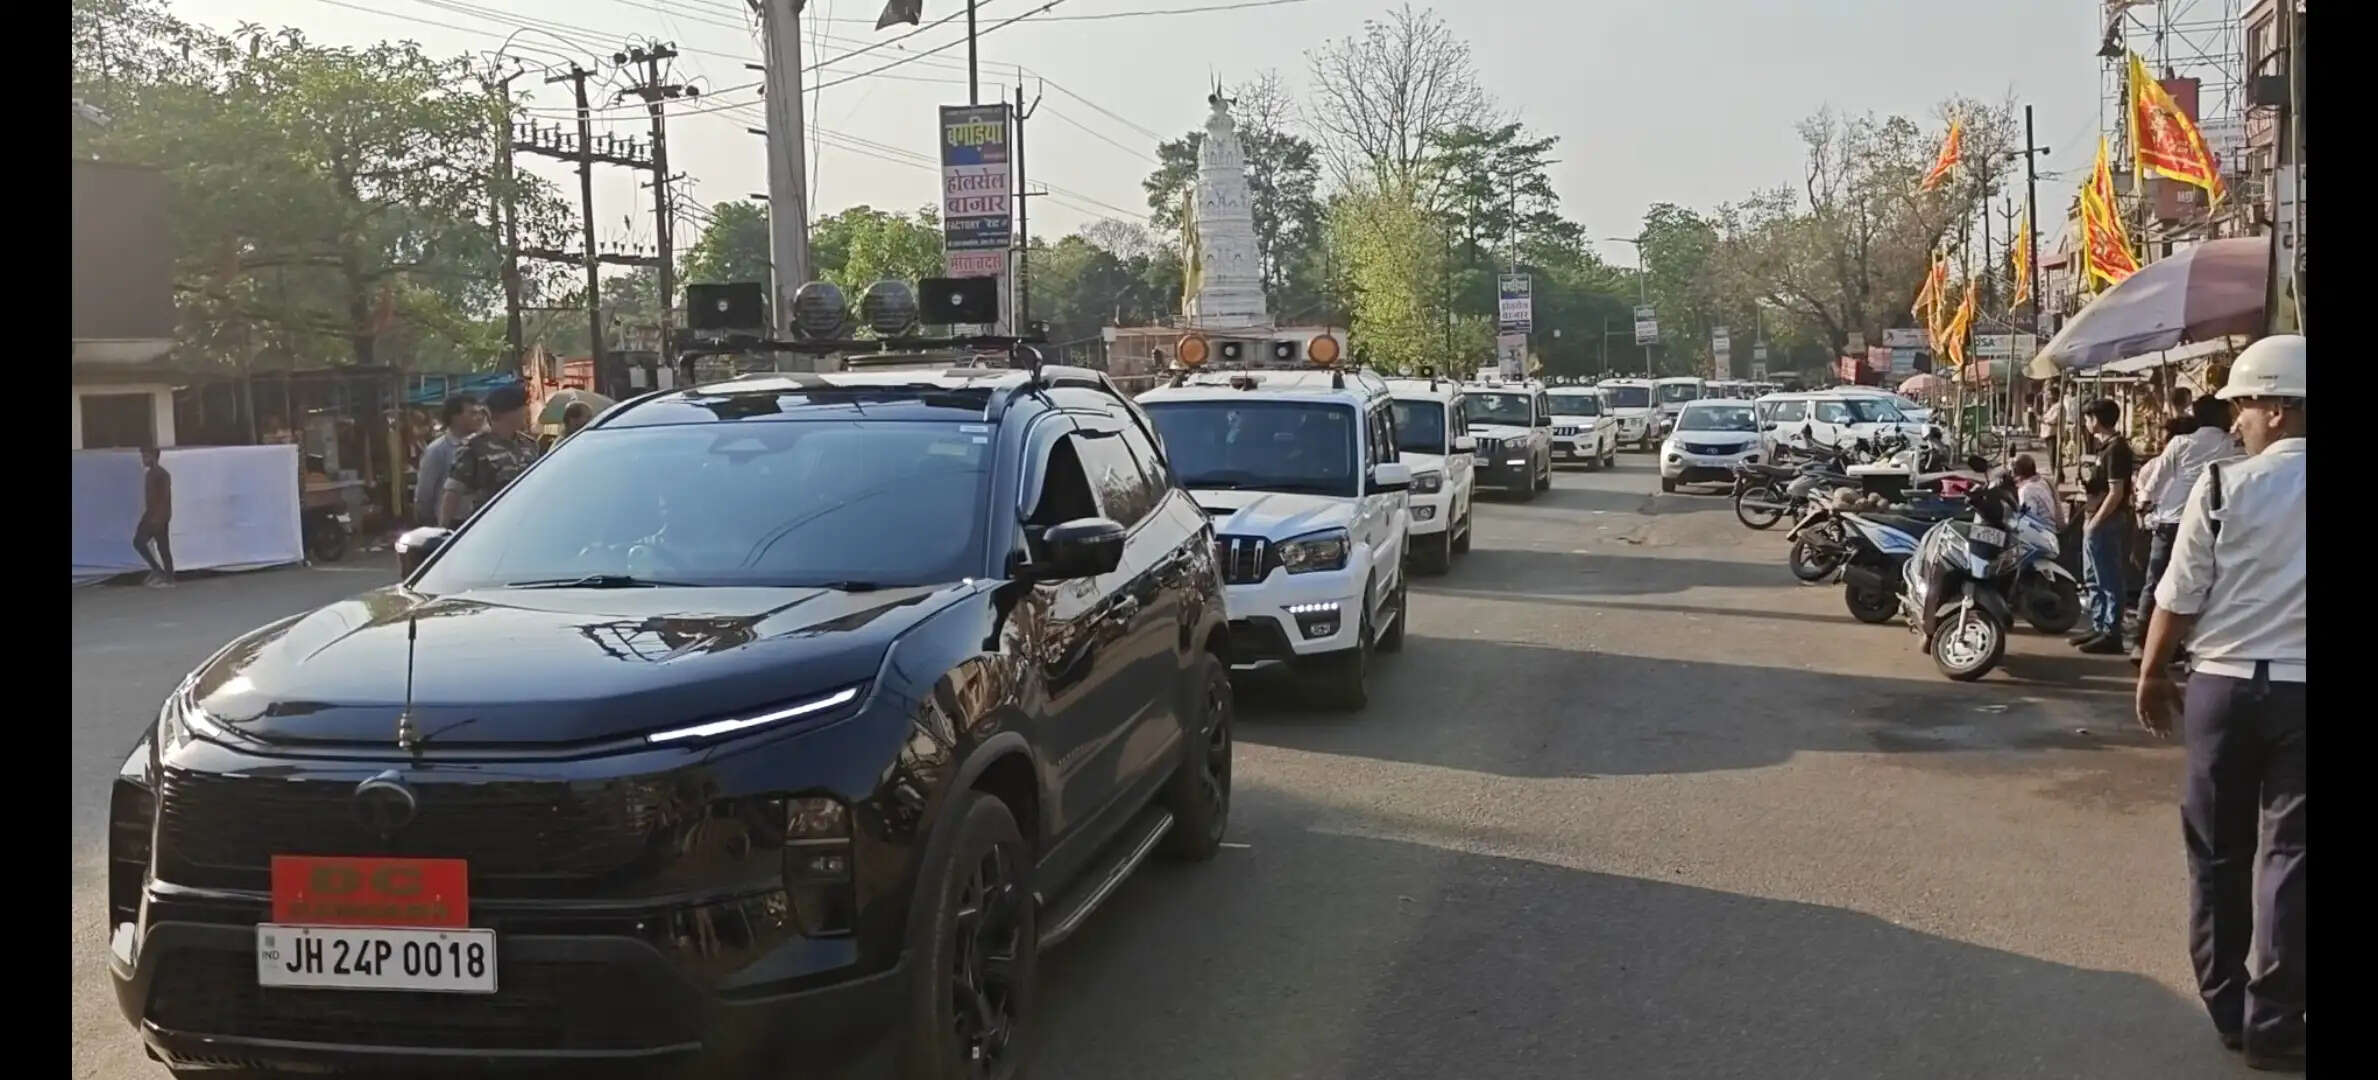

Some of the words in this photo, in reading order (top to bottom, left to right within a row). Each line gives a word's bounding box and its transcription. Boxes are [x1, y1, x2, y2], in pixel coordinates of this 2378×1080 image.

[946, 168, 1004, 193] होलसेल
[946, 195, 1006, 213] बाजार
[286, 937, 323, 974] JH
[333, 939, 392, 975] 24P
[403, 941, 485, 978] 0018
